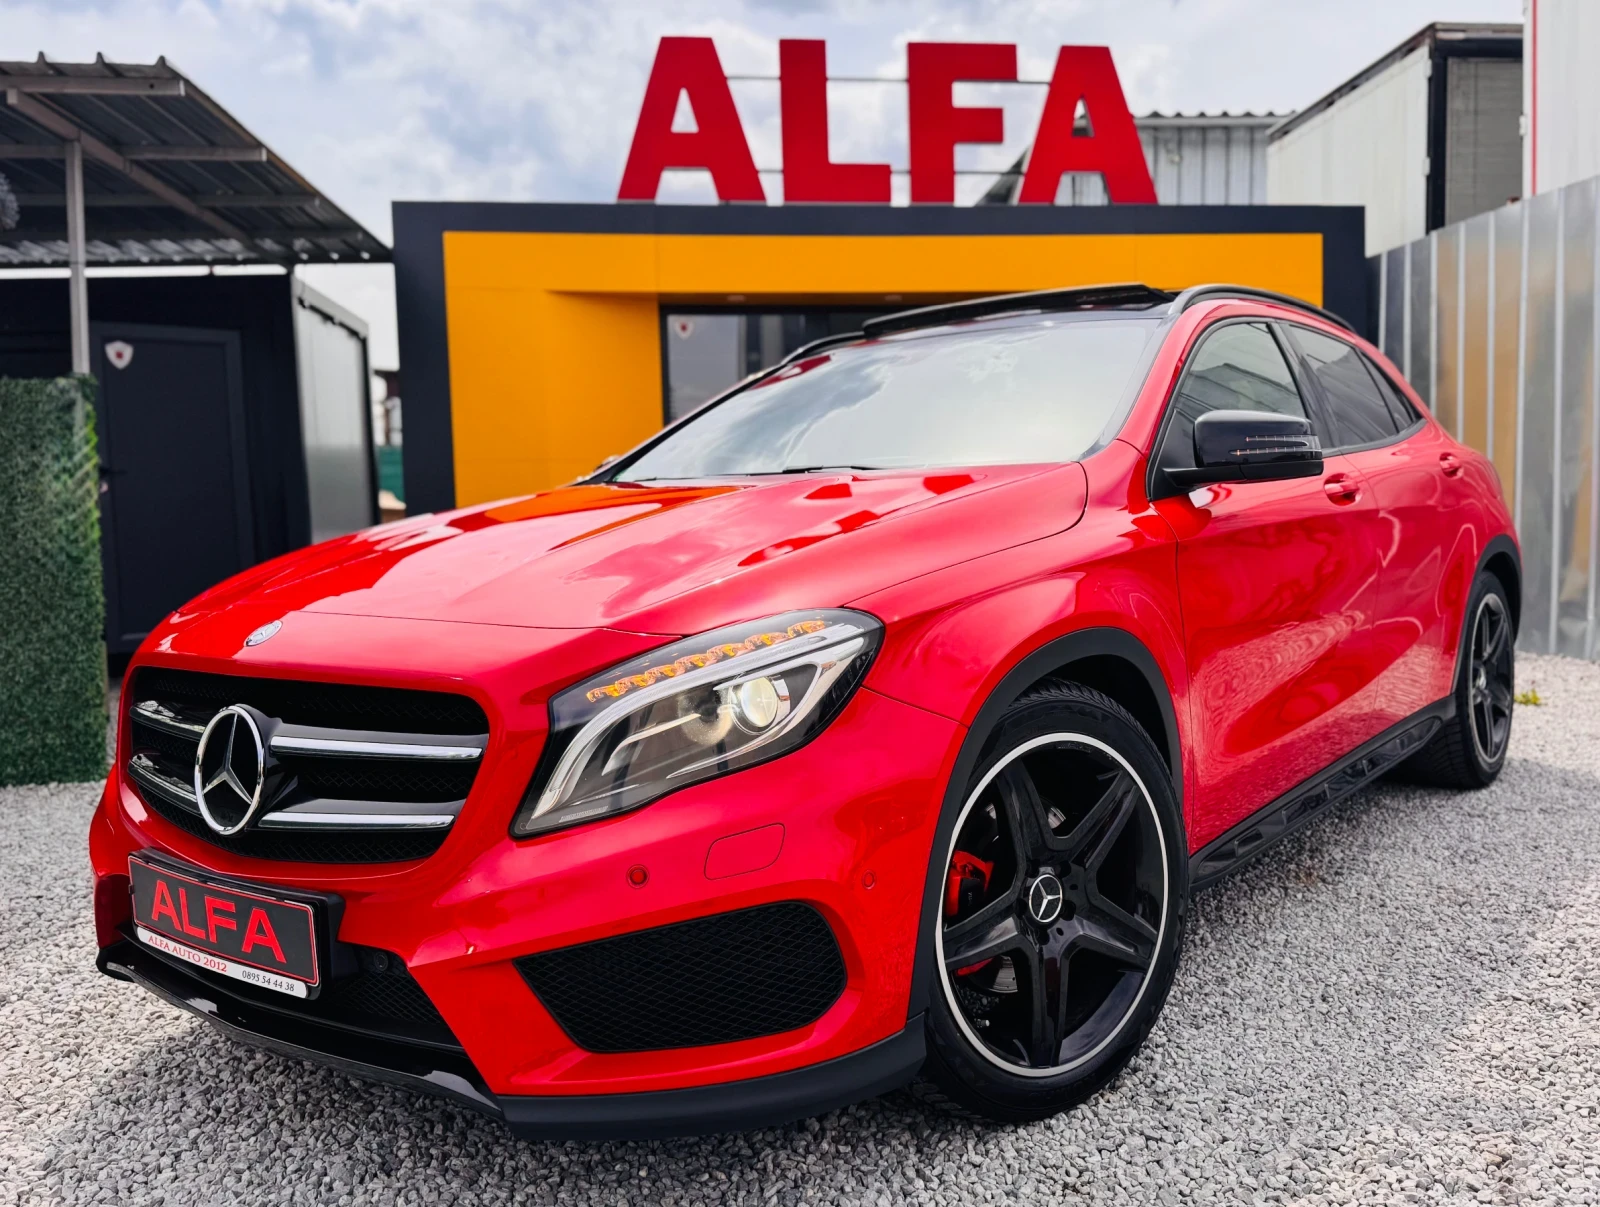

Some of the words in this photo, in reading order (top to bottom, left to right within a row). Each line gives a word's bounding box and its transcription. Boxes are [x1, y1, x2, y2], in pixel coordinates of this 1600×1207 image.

[616, 36, 1159, 205] ALFA
[151, 880, 287, 964] ALFA
[148, 935, 170, 951] ALFA
[172, 945, 201, 963] AUTO
[203, 956, 227, 972] 2012
[242, 970, 260, 982] 0895
[261, 975, 271, 985] 54
[273, 979, 283, 989] 44
[285, 981, 295, 992] 38
